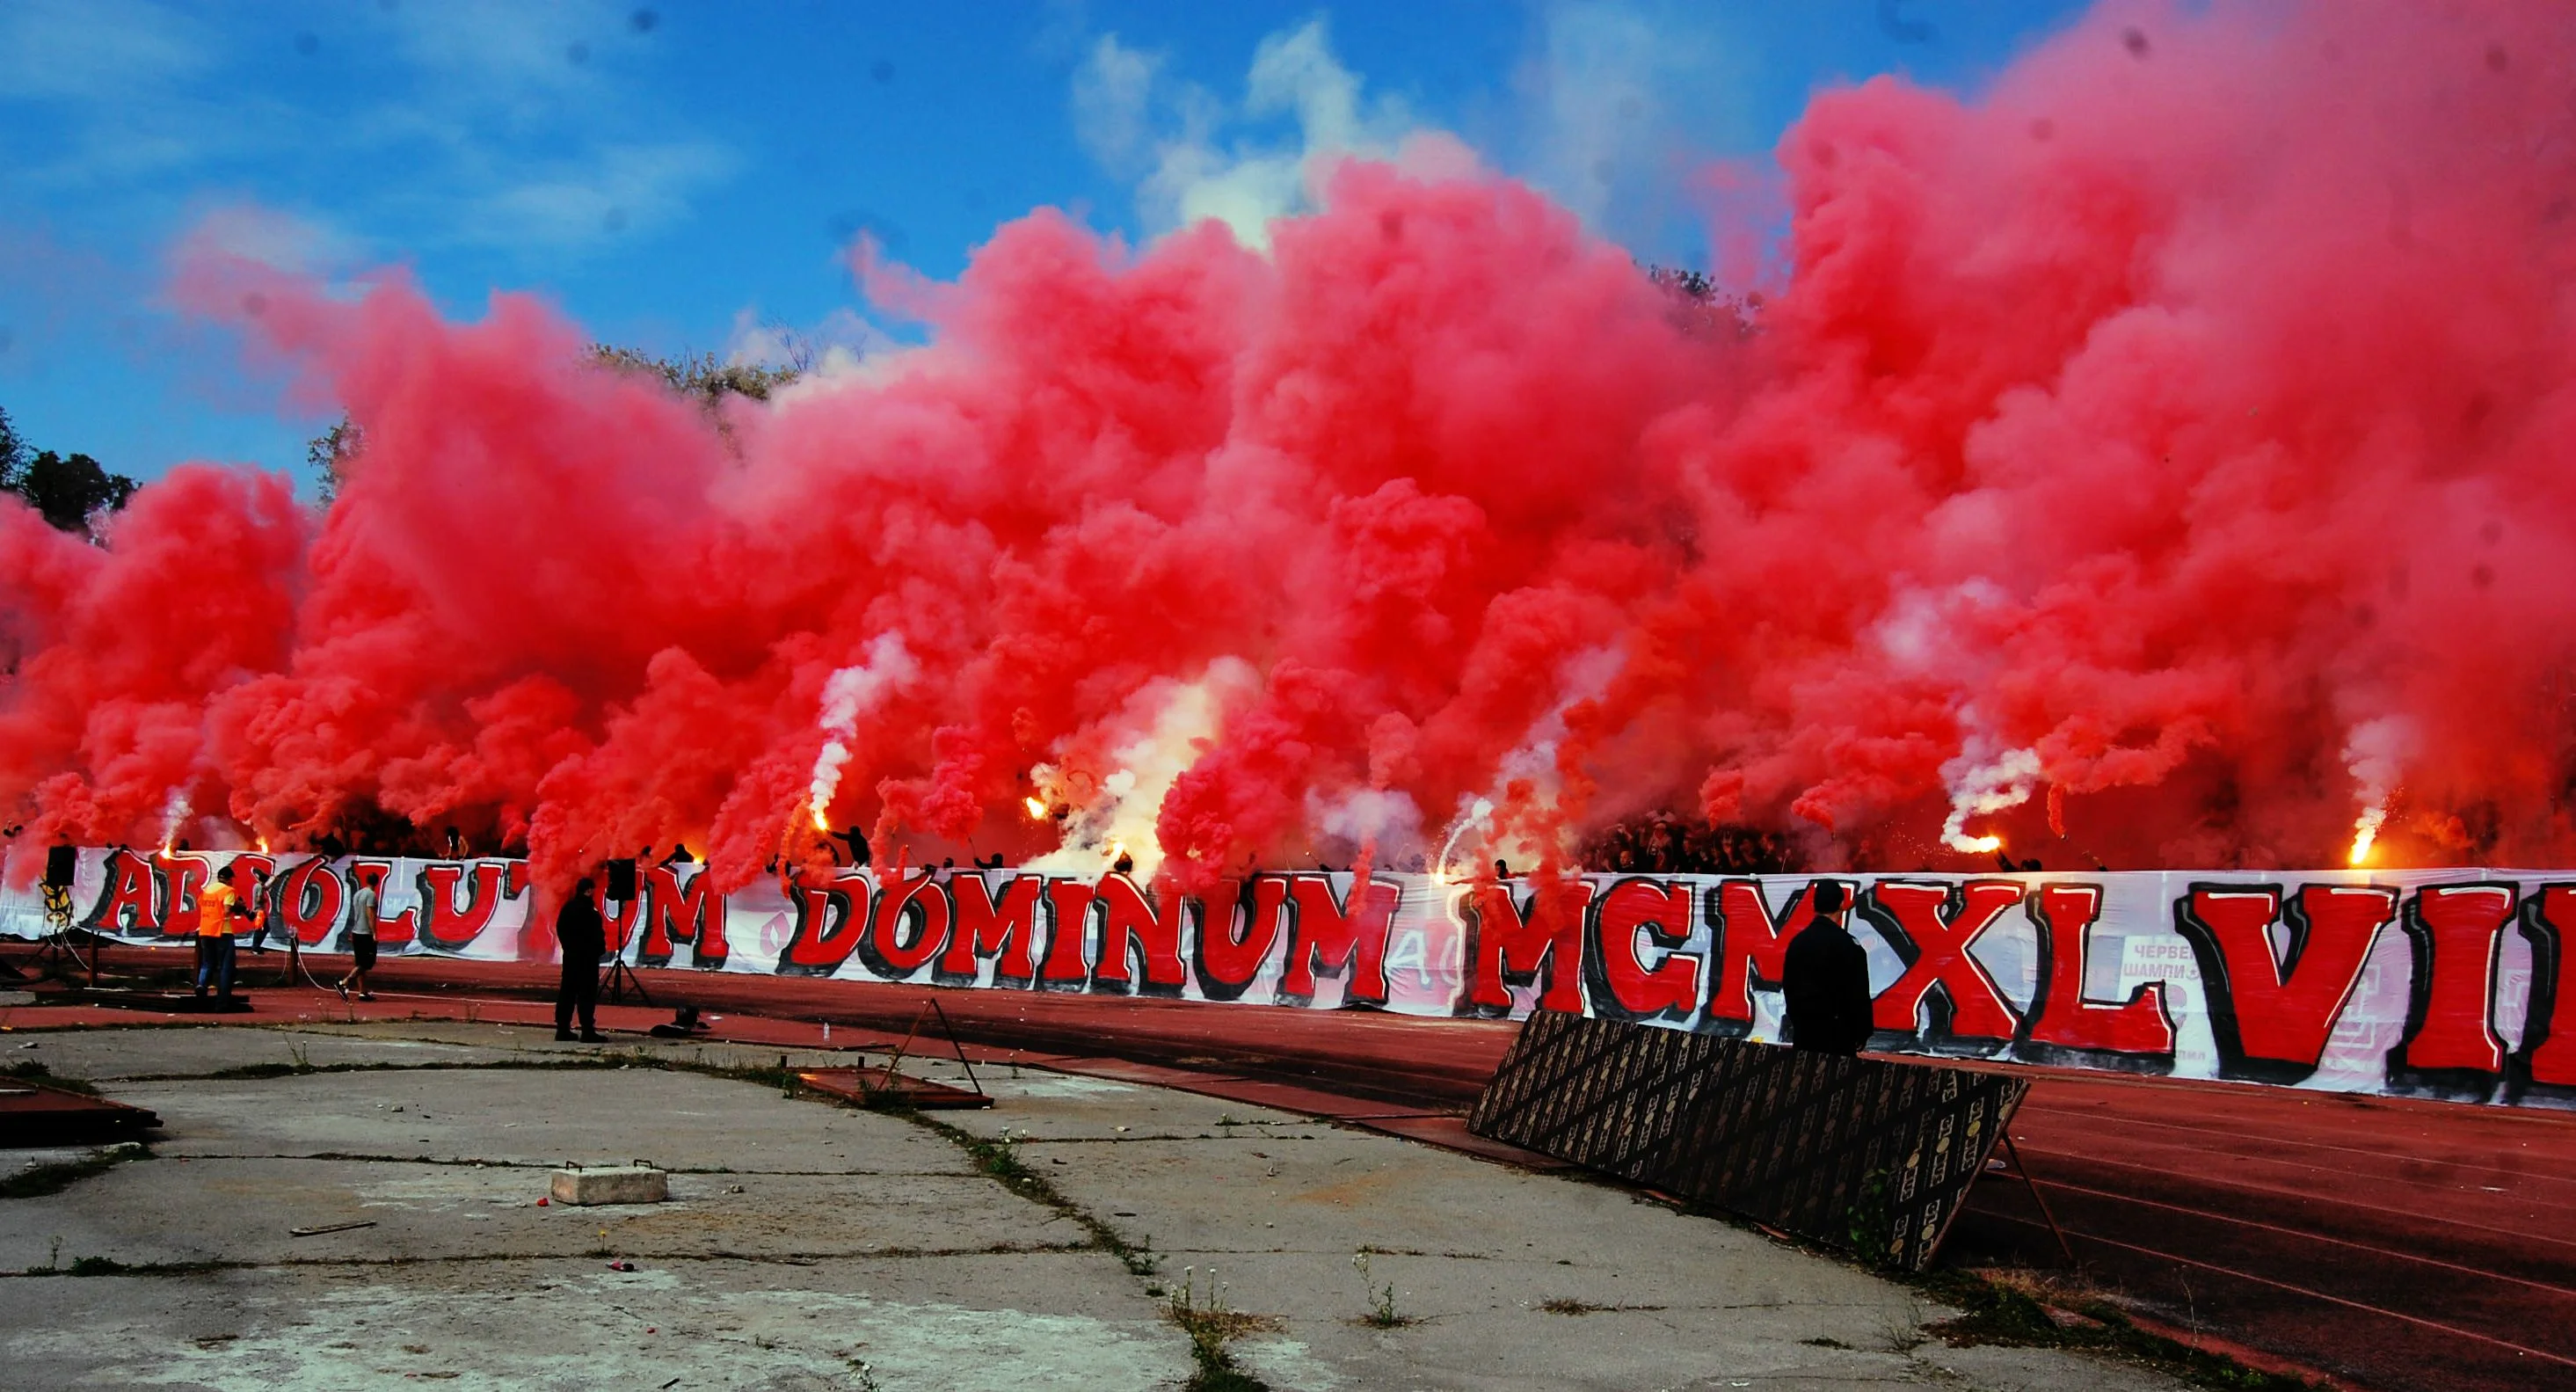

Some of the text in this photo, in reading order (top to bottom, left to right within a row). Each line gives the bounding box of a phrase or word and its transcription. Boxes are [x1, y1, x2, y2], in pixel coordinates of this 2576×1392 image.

[777, 871, 1404, 1007] DOMINUM
[2135, 944, 2195, 960] ЧЕРВЕ
[1930, 1113, 1955, 1188] GLOBUS
[1961, 1097, 1984, 1171] GLOBUS
